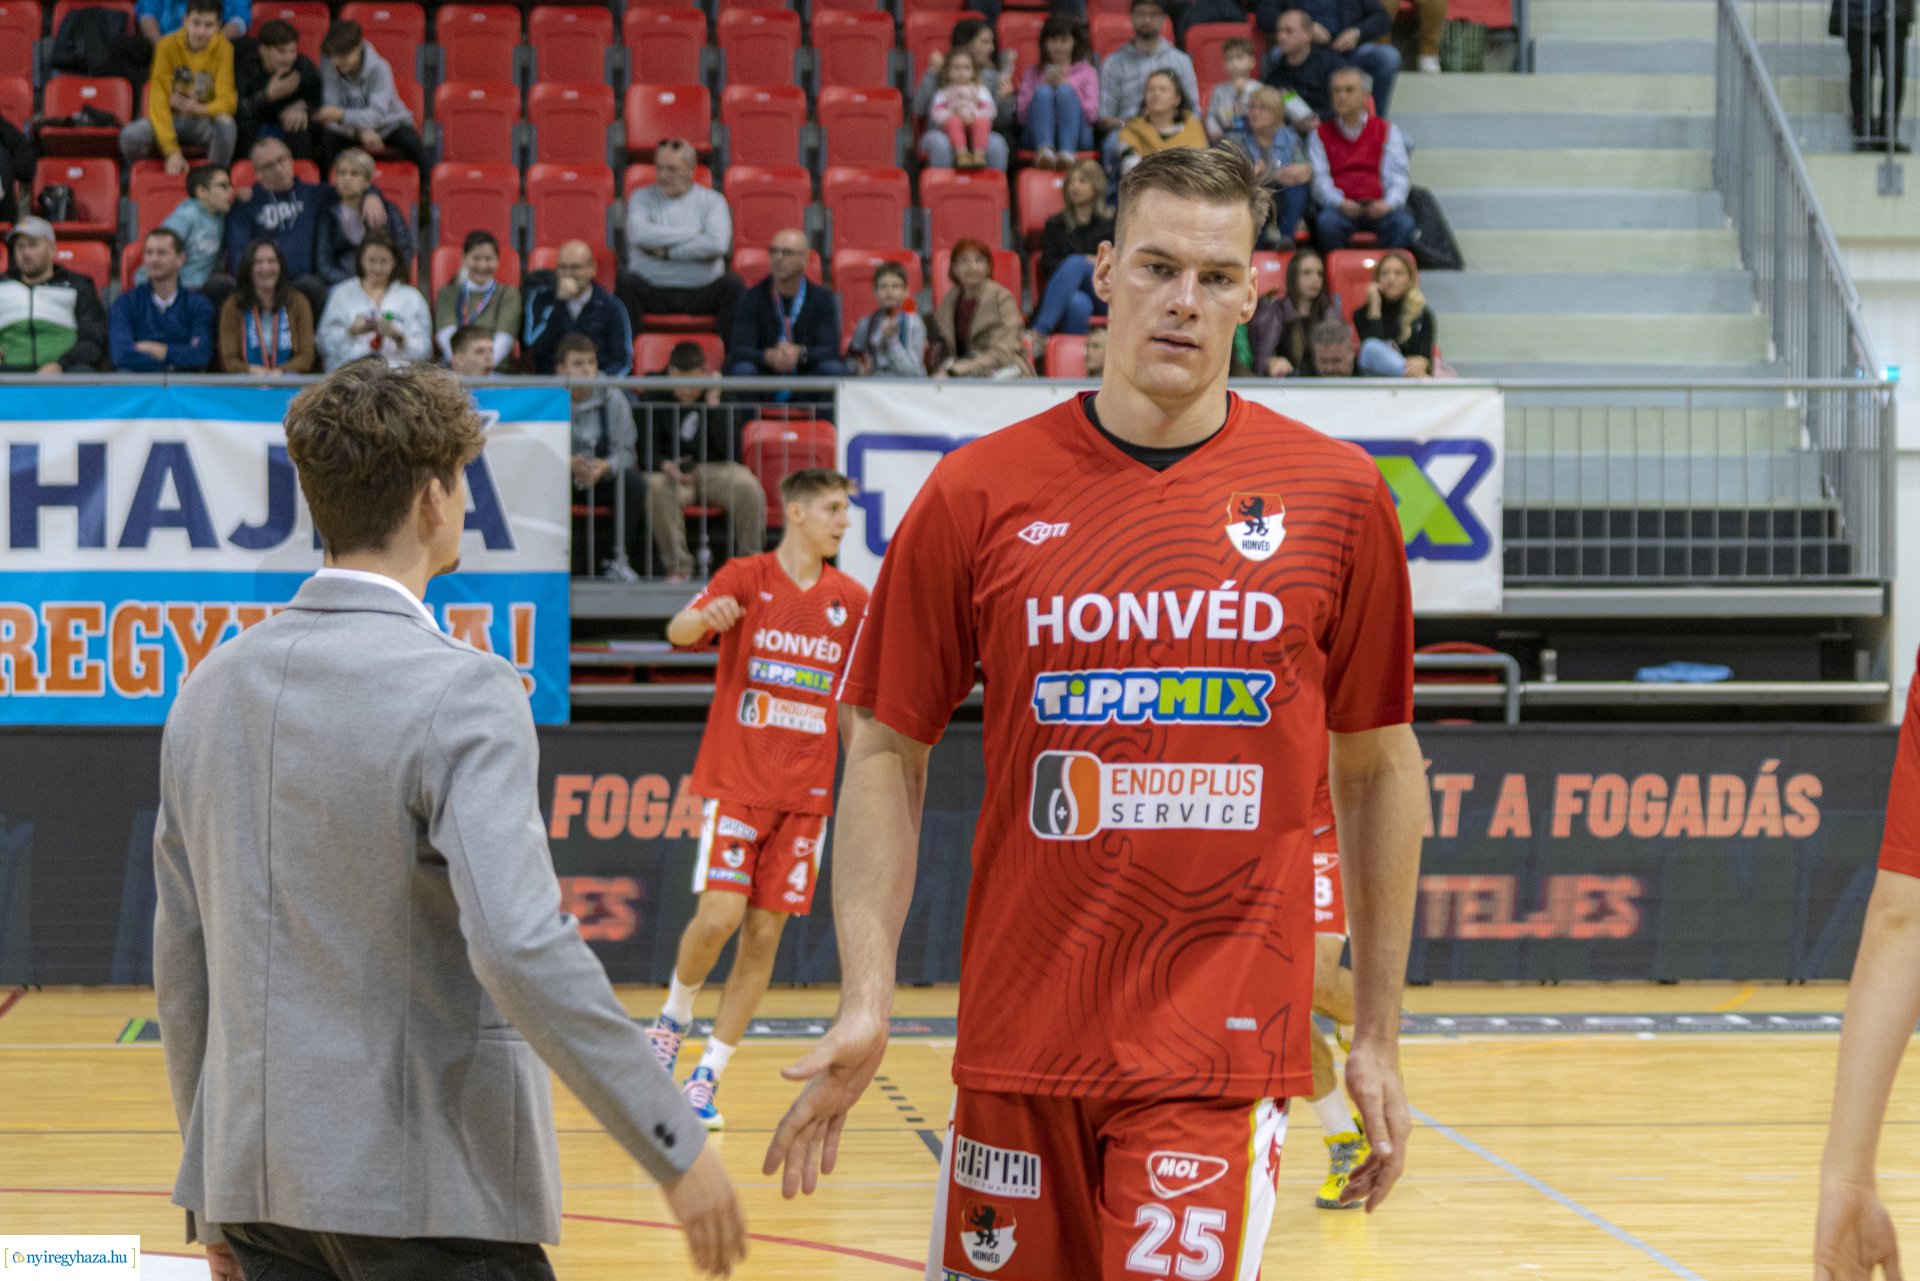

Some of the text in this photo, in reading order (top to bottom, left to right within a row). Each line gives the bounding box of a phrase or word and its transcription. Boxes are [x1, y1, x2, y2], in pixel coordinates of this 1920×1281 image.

[1242, 539, 1271, 552] HONVÉD
[1026, 580, 1284, 646] HONVÉD
[754, 628, 842, 663] HONVÉD
[549, 773, 704, 840] FOGA
[1111, 802, 1256, 825] SERVICE
[1488, 774, 1532, 838] A
[1552, 758, 1823, 838] FOGADÁS
[787, 861, 809, 892] 4
[1156, 1157, 1200, 1180] MOL
[972, 1249, 1001, 1265] HONVÉD
[1125, 1202, 1227, 1281] 25
